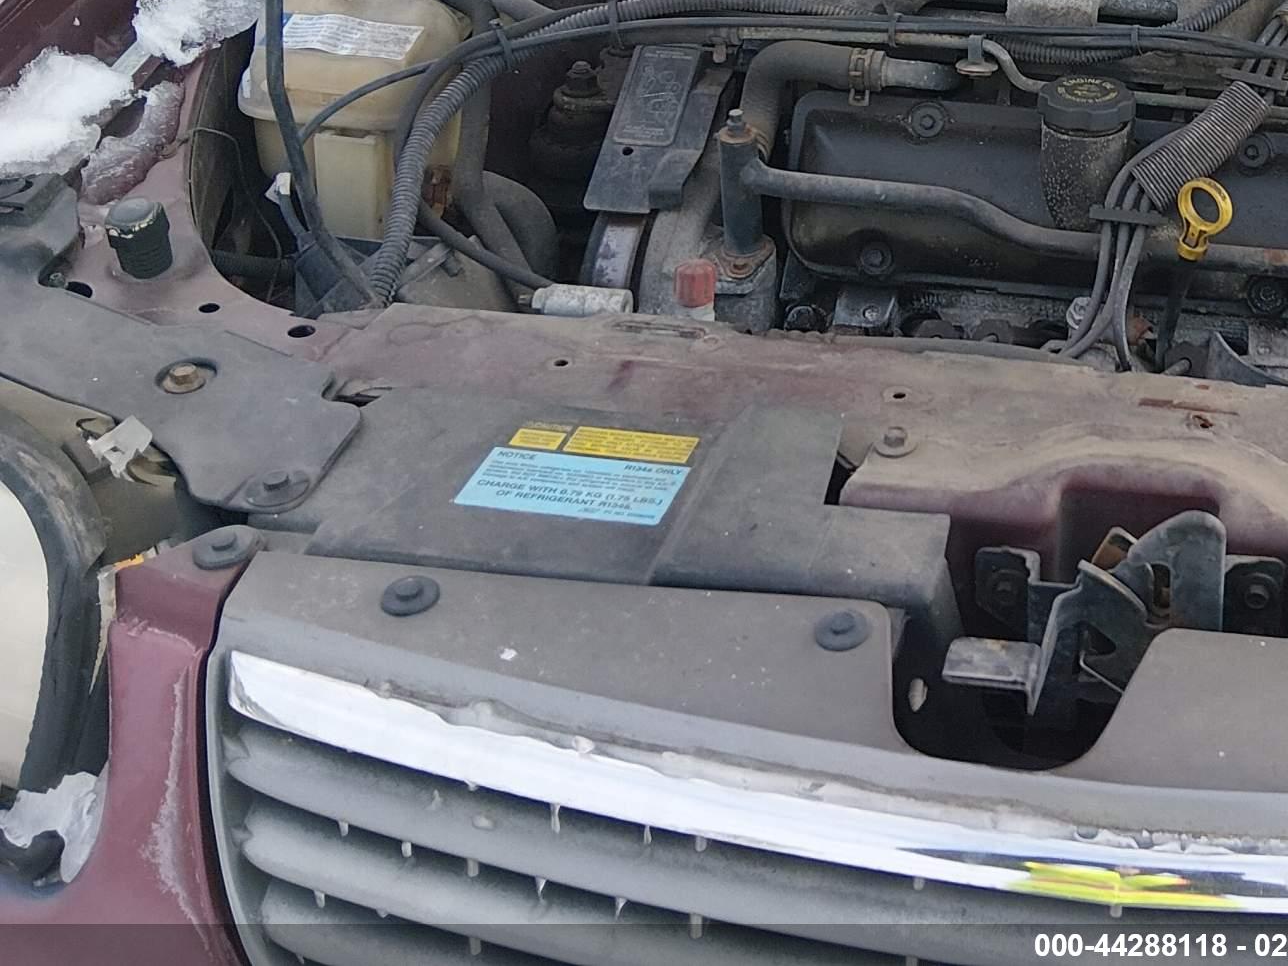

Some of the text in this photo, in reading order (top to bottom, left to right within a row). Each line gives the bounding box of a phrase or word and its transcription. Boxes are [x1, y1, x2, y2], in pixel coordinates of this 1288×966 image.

[497, 450, 538, 461] NOTICE
[655, 467, 683, 476] ONLY
[476, 479, 526, 491] CHARGE
[528, 484, 557, 494] WITH
[584, 491, 604, 499] KG
[495, 489, 512, 497] OF
[514, 492, 595, 506] REFRIGERANT
